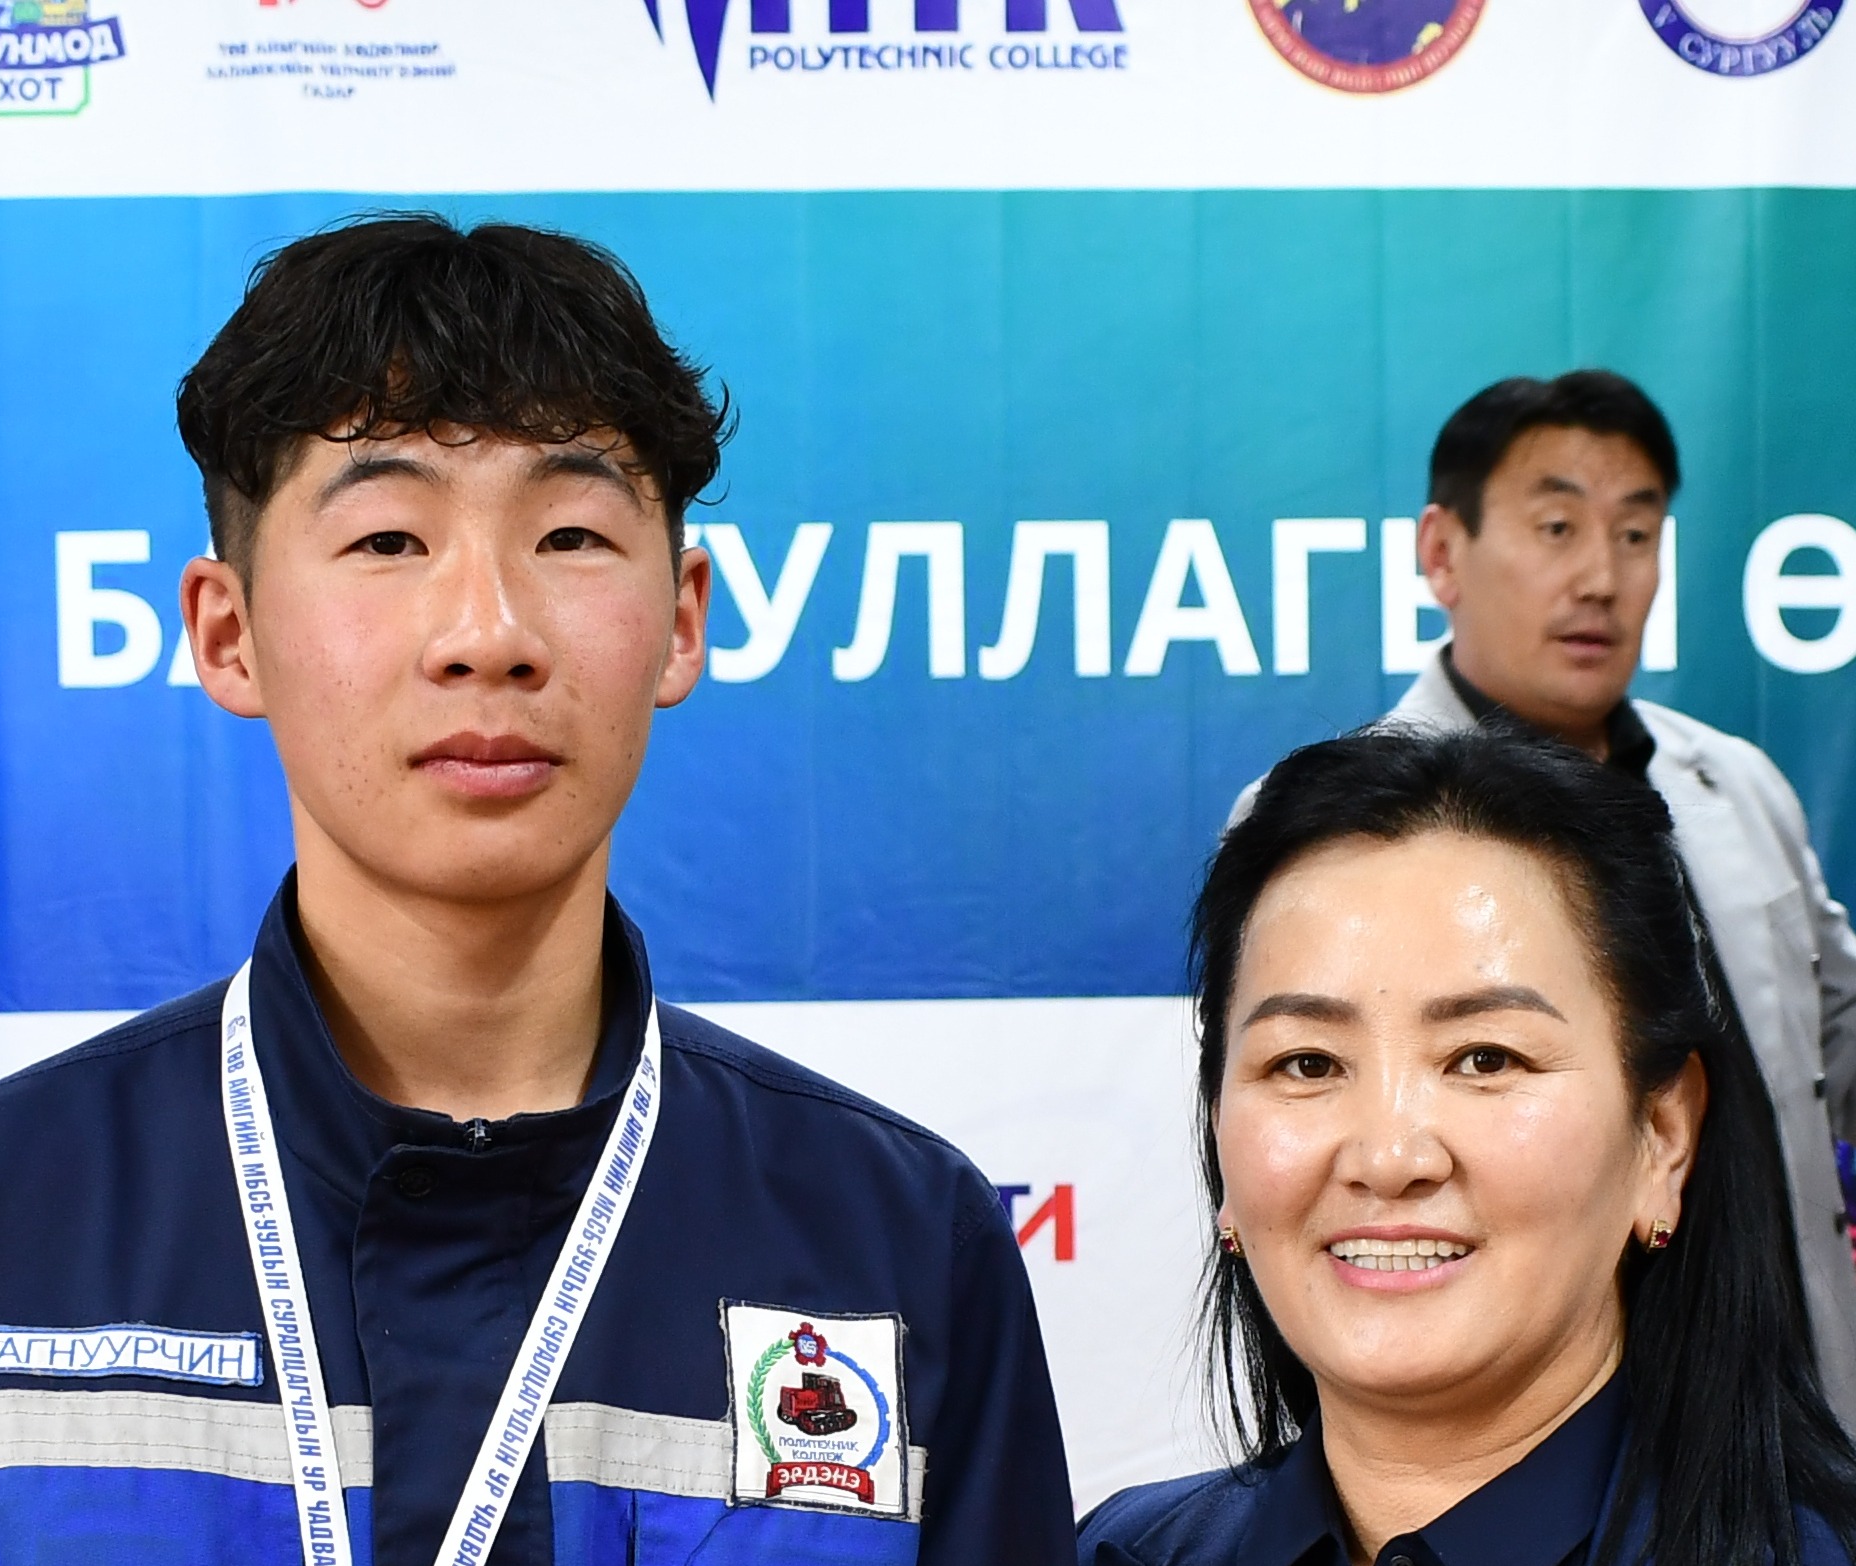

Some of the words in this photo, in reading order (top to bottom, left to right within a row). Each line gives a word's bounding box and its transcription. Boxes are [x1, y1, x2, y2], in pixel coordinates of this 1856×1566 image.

[749, 43, 974, 71] POLYTECHNIC
[989, 43, 1128, 70] COLLEGE
[0, 76, 63, 101] ХОТ
[227, 1042, 245, 1074] ТӨВ
[633, 1082, 652, 1118] ТӨВ
[229, 1077, 265, 1156] АЙМГИЙН
[241, 1162, 291, 1290] МБСБ-УУДЫН
[554, 1192, 617, 1314] МБСБ-УУДЫН
[270, 1298, 322, 1457] СУРАЛЦАГЧДЫН
[494, 1315, 568, 1467] СУРАЛЦАГЧДЫН
[779, 1436, 859, 1452] ПОЛИТЕХНИК
[792, 1449, 846, 1463] КОЛЛЕЖ
[301, 1465, 327, 1492] УР
[484, 1468, 510, 1499] УР
[777, 1466, 861, 1488] ЭРДЭНЭ
